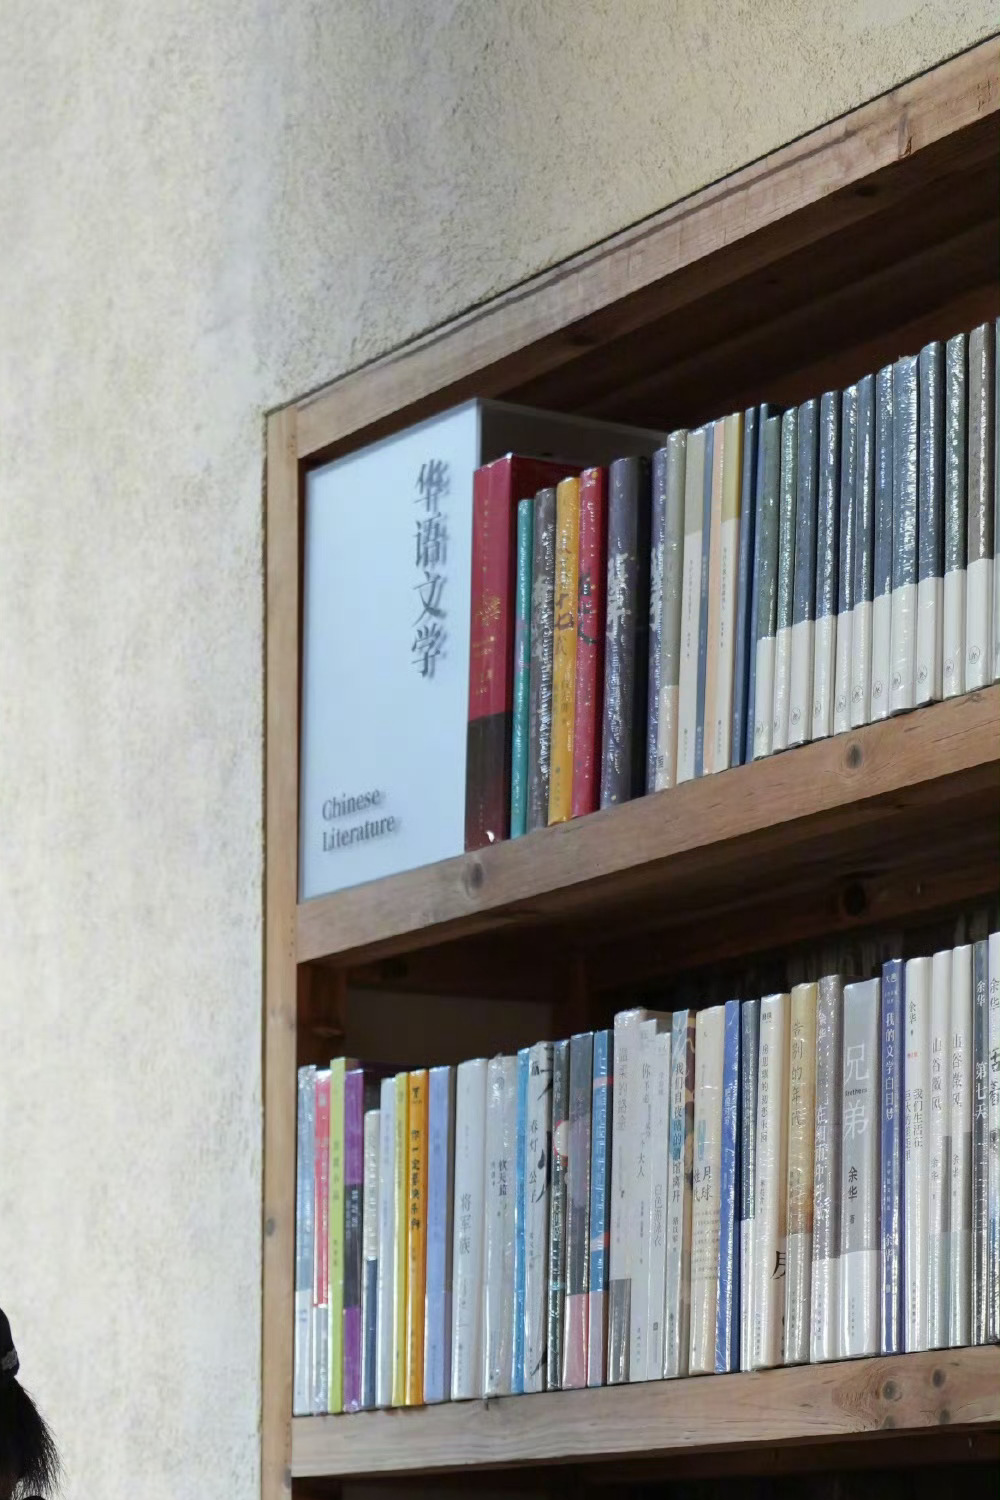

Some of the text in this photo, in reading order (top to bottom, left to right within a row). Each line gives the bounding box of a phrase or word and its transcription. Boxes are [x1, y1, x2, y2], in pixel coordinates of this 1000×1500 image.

[411, 459, 445, 678] 华语文学
[322, 789, 381, 821] Chinese
[322, 815, 396, 852] Literature
[909, 1001, 917, 1025] 余华
[976, 980, 987, 1007] 余华
[791, 1020, 803, 1127] 告别的年代
[885, 1012, 895, 1121] 我的文学白日梦
[931, 1037, 942, 1112] 山谷微风
[952, 1032, 963, 1108] 山谷微风
[975, 1061, 988, 1120] 第七天
[913, 1088, 923, 1148] 我们生活在
[529, 1119, 538, 1204] 春灯公子
[701, 1165, 712, 1201] 月球
[848, 1165, 858, 1199] 余华
[459, 1193, 472, 1254] 将军族
